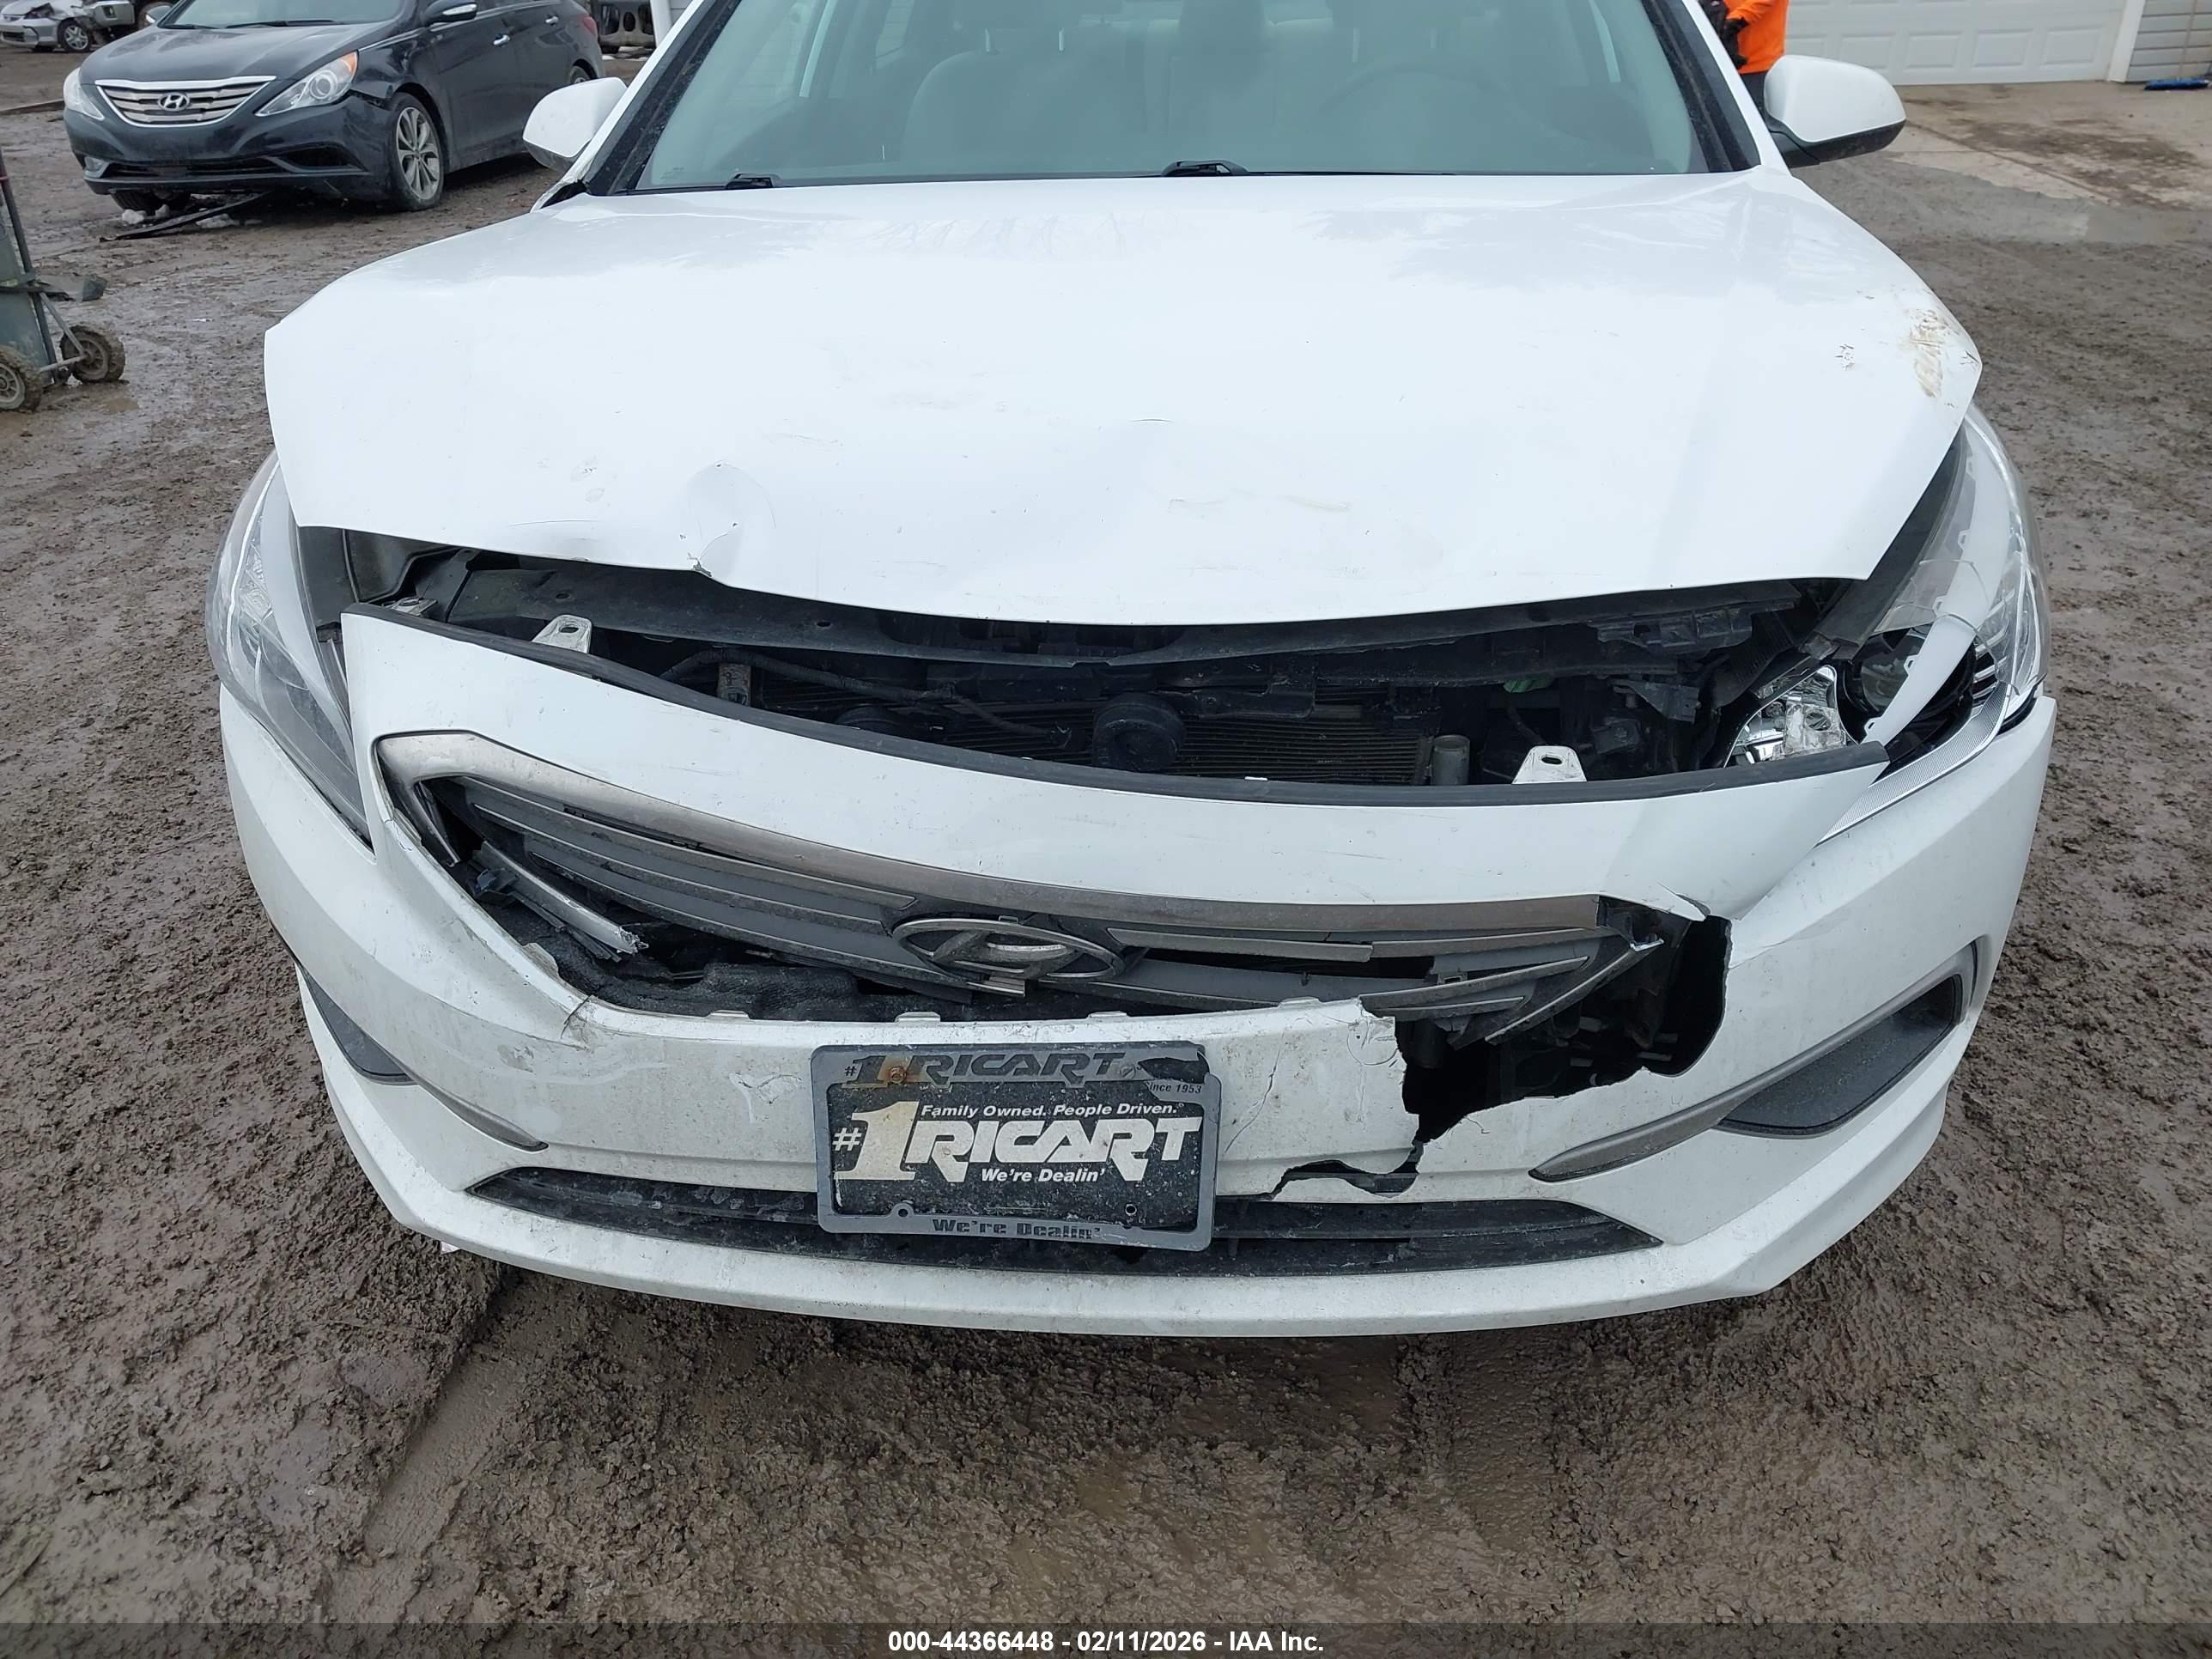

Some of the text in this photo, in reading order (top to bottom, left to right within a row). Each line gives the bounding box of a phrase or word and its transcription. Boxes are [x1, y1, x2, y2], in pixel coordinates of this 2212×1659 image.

[906, 1052, 1126, 1085] RICART
[1176, 1084, 1202, 1093] 1953
[921, 1103, 1177, 1119] Family Owned. People Driven.
[904, 1116, 1202, 1182] RICART
[981, 1169, 1105, 1182] We're Dealin'
[933, 1218, 1006, 1234] We're
